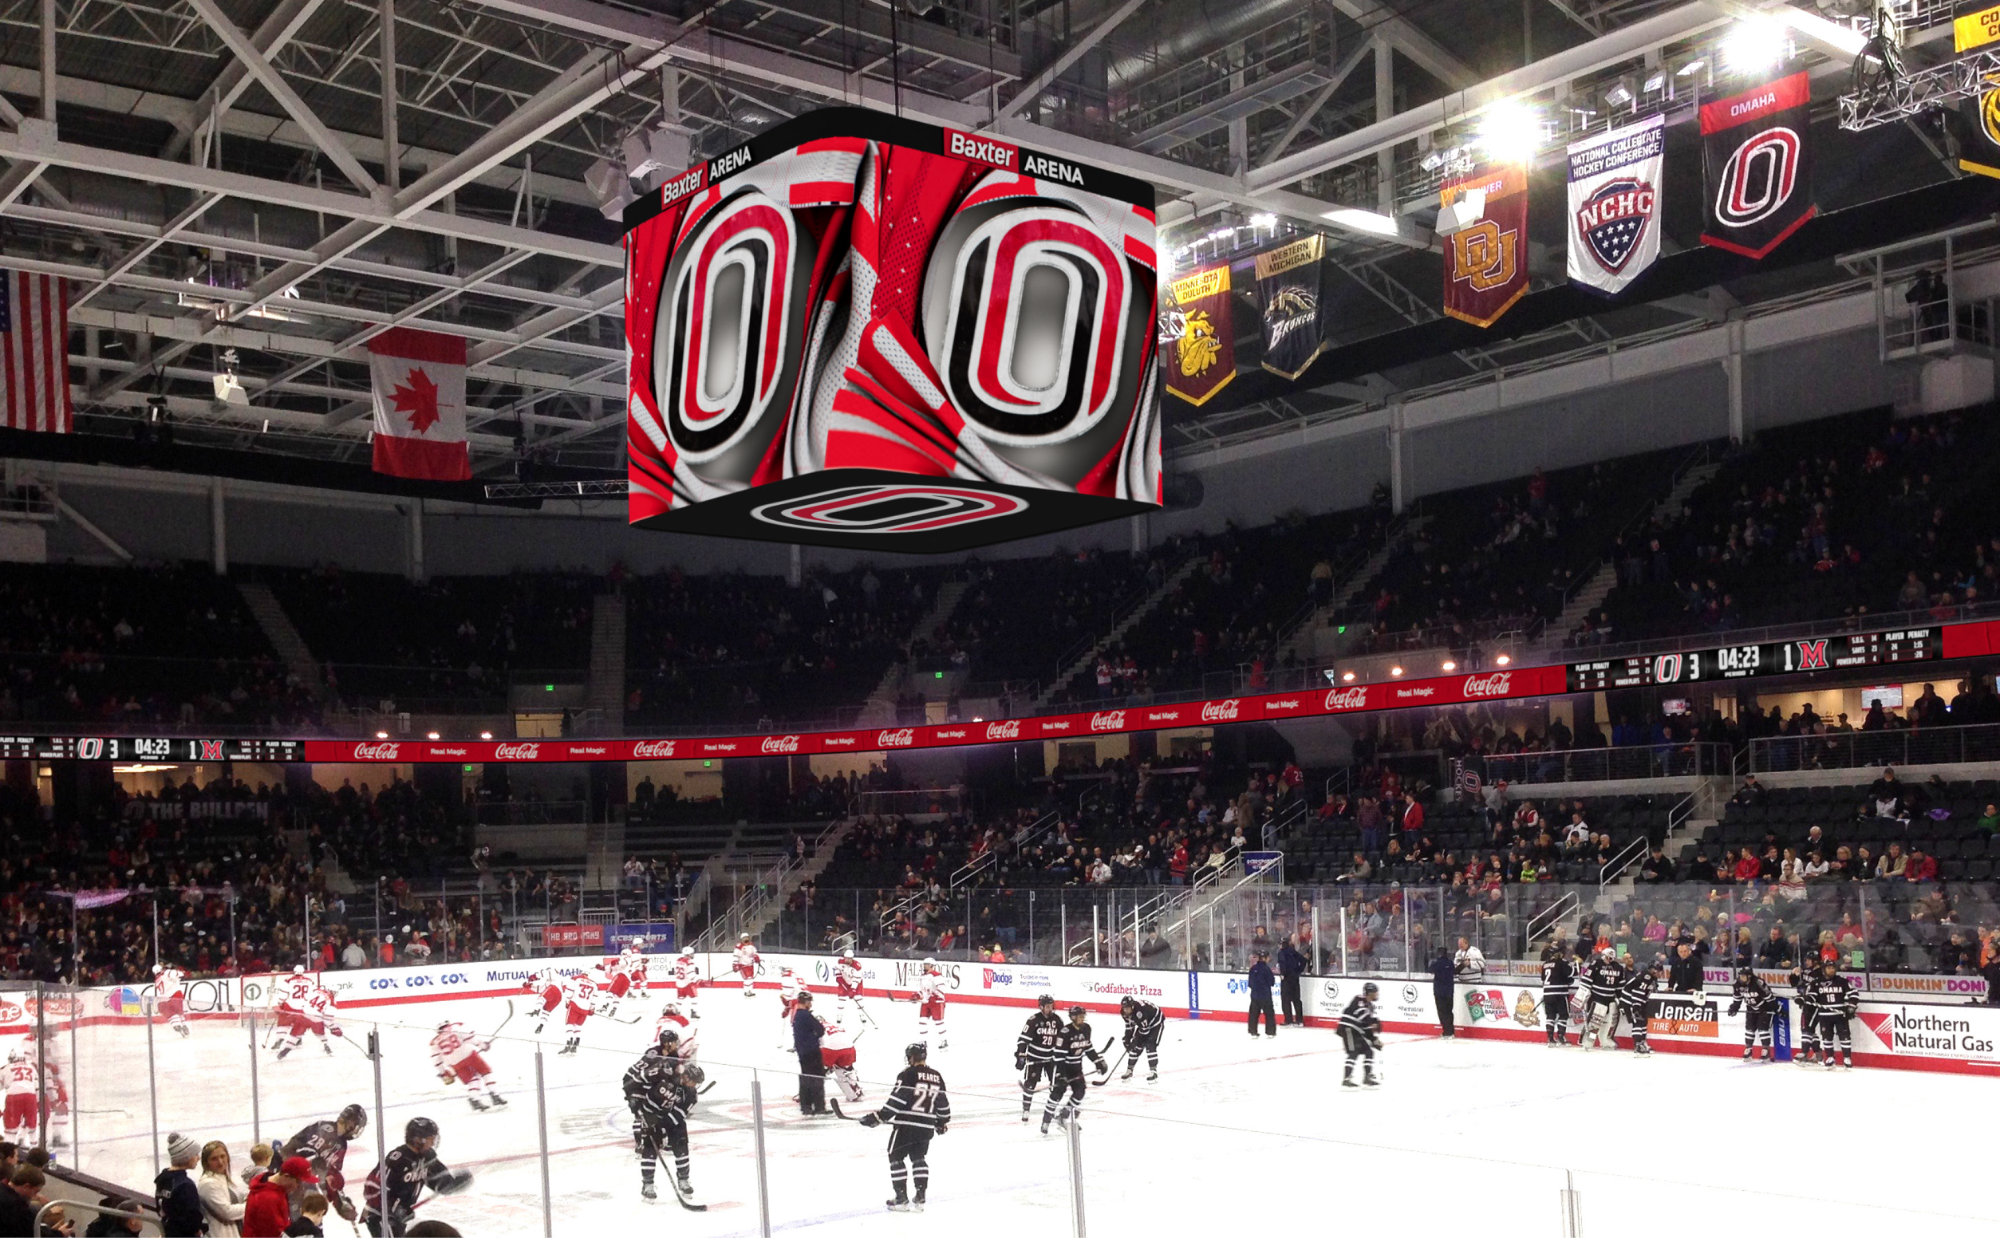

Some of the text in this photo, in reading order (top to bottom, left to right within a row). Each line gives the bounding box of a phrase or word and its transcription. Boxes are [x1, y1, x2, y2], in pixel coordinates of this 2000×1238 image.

[1988, 24, 2000, 37] C
[1730, 92, 1776, 117] OMAHA
[1571, 128, 1662, 167] NATIONAL COLLEGIATE
[951, 132, 1085, 186] Baxter ARENA
[1573, 141, 1660, 178] HOCKEY CONFERENCE
[663, 145, 752, 205] Baxter ARENA
[1580, 191, 1653, 232] NCHC
[1270, 241, 1309, 262] WESTERN
[1452, 219, 1518, 292] DU
[1268, 250, 1312, 273] MICHIGAN
[1175, 271, 1218, 293] MINNESOTA
[1182, 285, 1211, 300] DULUTH
[1885, 630, 1929, 641] PLAYER PENALTY
[1718, 645, 1760, 670] 04:23
[1784, 639, 1830, 671] 1 M
[1689, 653, 1699, 680] 3
[1397, 686, 1434, 698] Real Magic
[1266, 699, 1299, 710] Real Magic
[1149, 711, 1179, 721] Real Magic
[1042, 721, 1070, 730] Real Magic
[839, 736, 855, 745] Magic
[937, 730, 966, 739] Real Magic
[110, 739, 118, 759] 3
[135, 739, 170, 755] 04:23
[190, 740, 224, 761] 1 M
[447, 748, 466, 756] Magic
[586, 747, 606, 755] Magic
[718, 743, 737, 751] Magic
[150, 803, 184, 819] THE
[190, 802, 269, 819] BULLPEN
[369, 972, 469, 990] COX COX COX
[486, 970, 530, 982] MUTUAL
[993, 971, 1012, 984] Dodge
[1544, 969, 1552, 985] 2
[1882, 977, 1947, 991] DUNKIN'
[292, 985, 308, 999] 28
[579, 984, 594, 1000] 37
[1094, 982, 1163, 996] Godfather's Pizza
[1819, 986, 1843, 994] OMAHA
[309, 996, 326, 1012] 44
[1655, 1002, 1713, 1022] Jensen
[1653, 1020, 1699, 1035] TIRE & AUTO
[1894, 1010, 1970, 1033] Northern
[1042, 1035, 1053, 1045] 20
[1894, 1032, 1993, 1052] Natural Gas
[11, 1067, 33, 1081] 33
[918, 1072, 940, 1084] PEARCE
[911, 1082, 940, 1113] 27
[307, 1134, 325, 1149] 28
